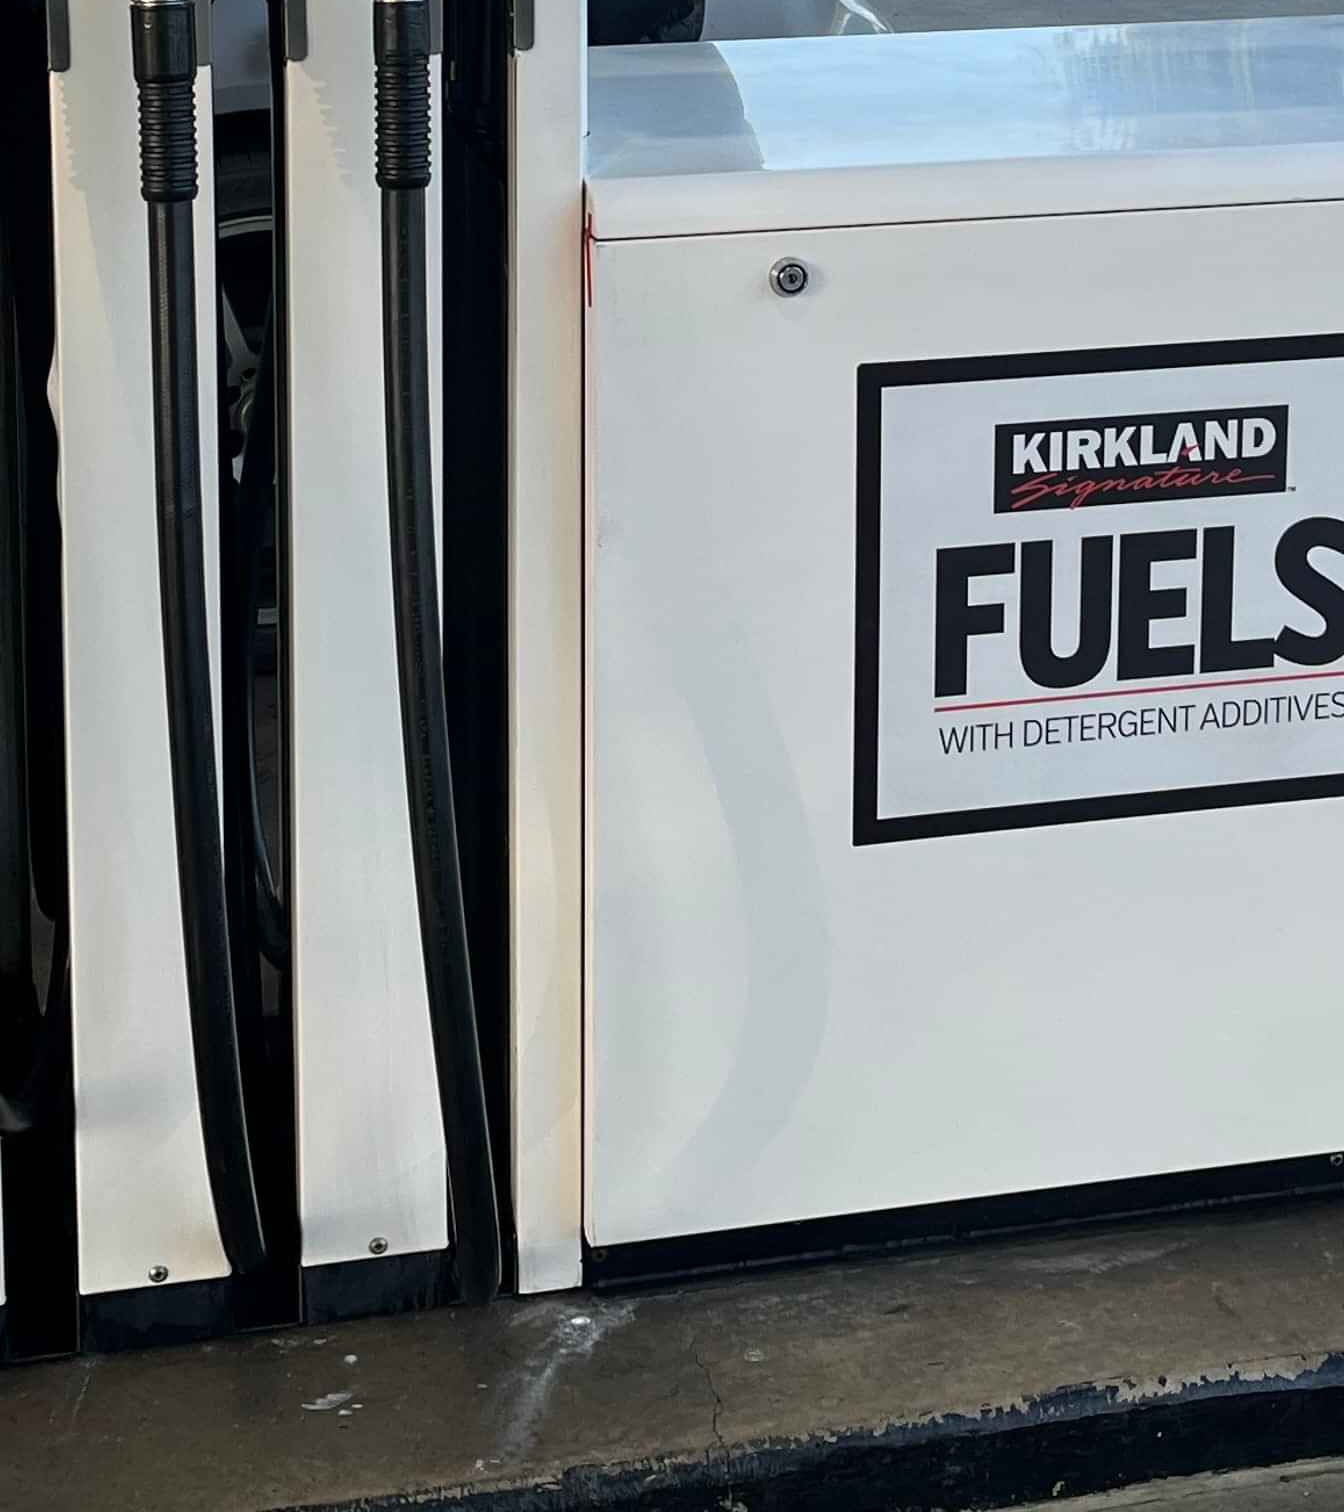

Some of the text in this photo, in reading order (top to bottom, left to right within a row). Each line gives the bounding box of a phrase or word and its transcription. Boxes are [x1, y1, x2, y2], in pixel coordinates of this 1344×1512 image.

[1012, 417, 1277, 475] KIRKLAND
[1010, 466, 1276, 510] Signature
[938, 725, 1014, 755] WITH
[1023, 704, 1197, 748] DETERGENT
